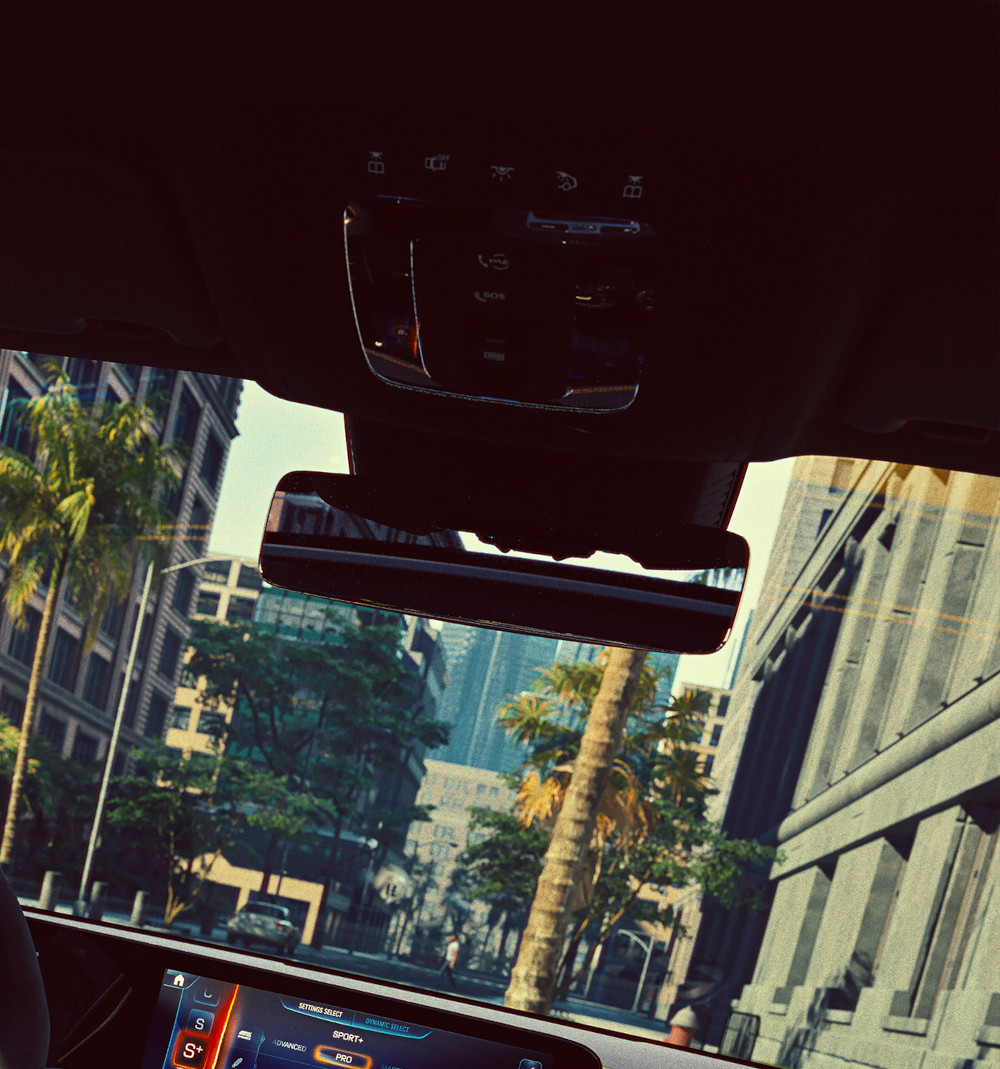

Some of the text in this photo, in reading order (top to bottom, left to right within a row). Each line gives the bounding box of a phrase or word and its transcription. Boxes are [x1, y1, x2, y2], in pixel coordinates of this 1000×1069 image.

[483, 291, 506, 301] SOS
[299, 1002, 344, 1018] SETTINGS SELECT
[195, 1018, 205, 1030] S
[365, 1017, 411, 1033] DYNAMIC SELECT
[332, 1030, 364, 1043] SPORT+
[183, 1043, 203, 1058] S+
[272, 1038, 307, 1053] ADVANCED
[335, 1053, 353, 1064] PRO
